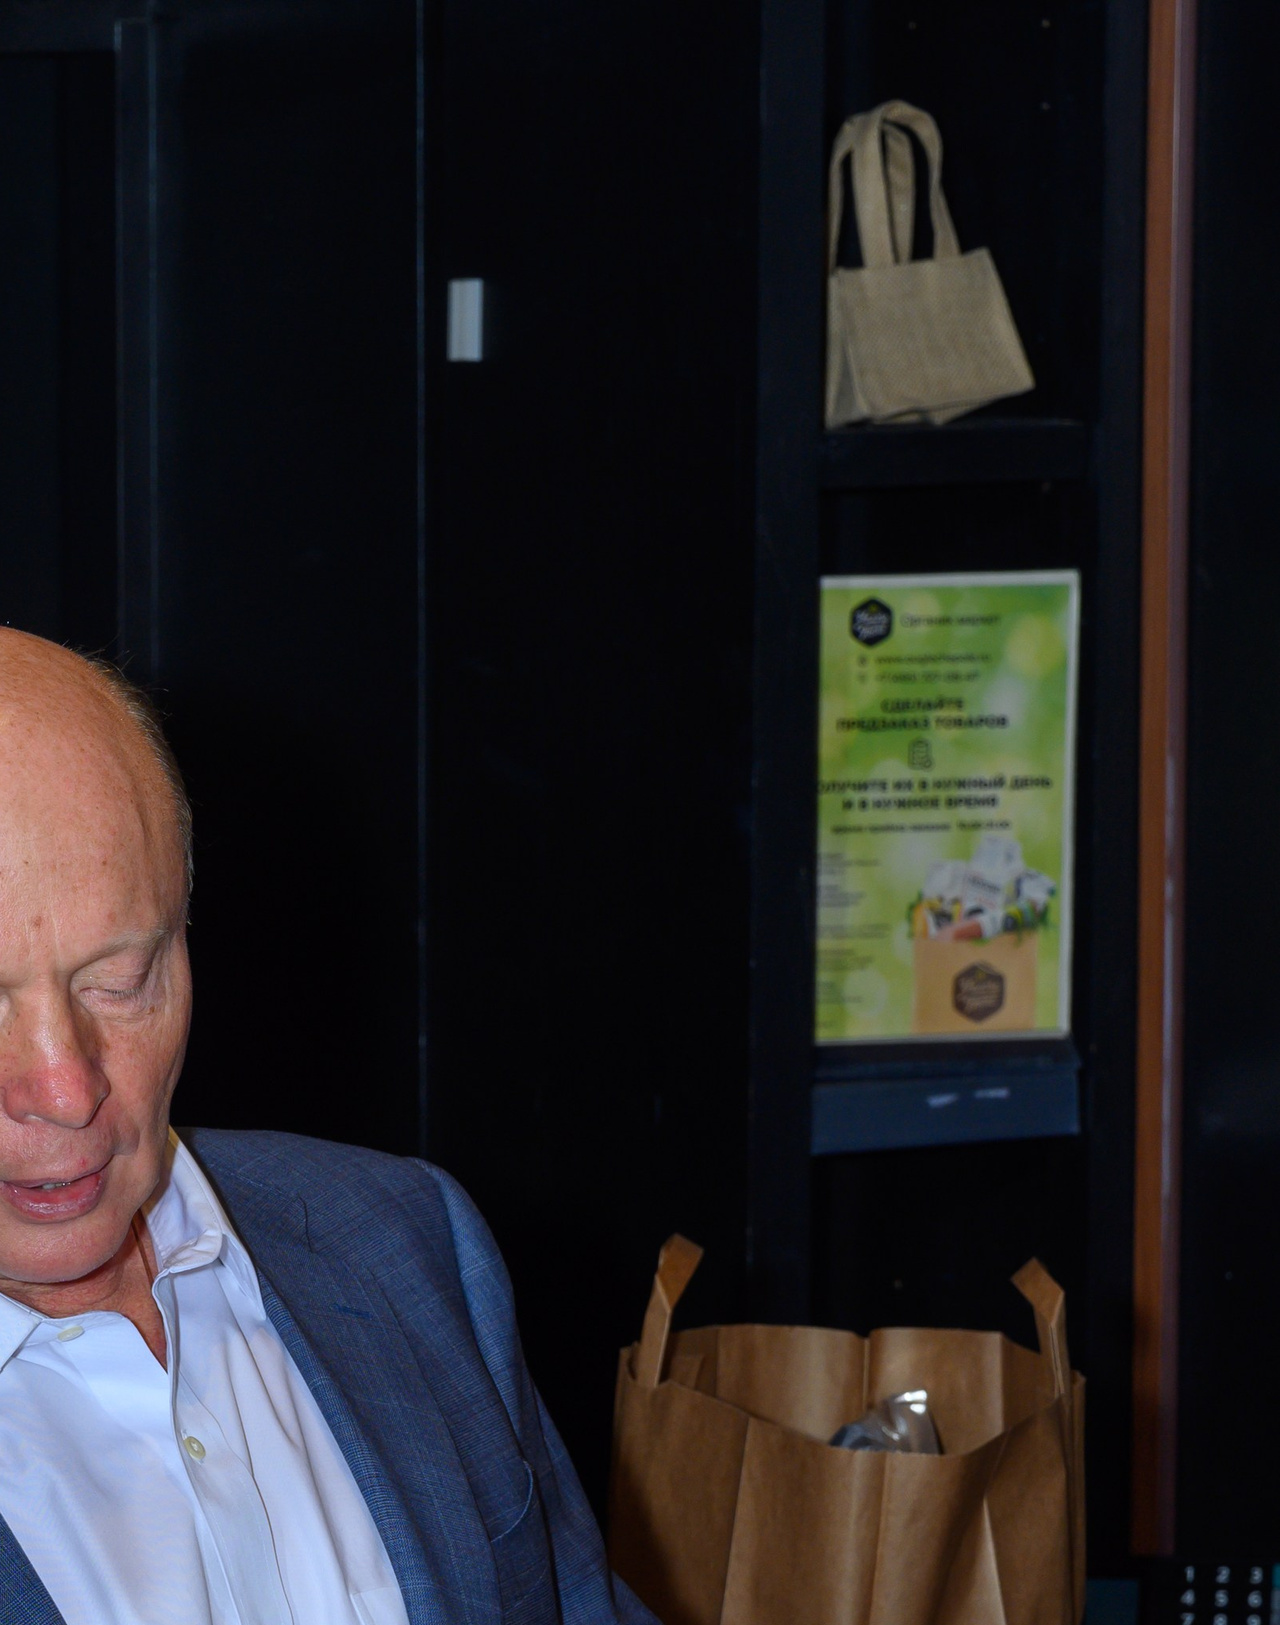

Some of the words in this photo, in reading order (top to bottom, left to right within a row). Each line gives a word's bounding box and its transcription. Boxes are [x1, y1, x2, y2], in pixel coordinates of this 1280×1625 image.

[1184, 1565, 1195, 1582] 1
[1215, 1565, 1231, 1584] 2
[1249, 1565, 1264, 1585] 3
[1180, 1588, 1195, 1606] 4
[1214, 1589, 1229, 1608] 5
[1247, 1590, 1263, 1608] 6
